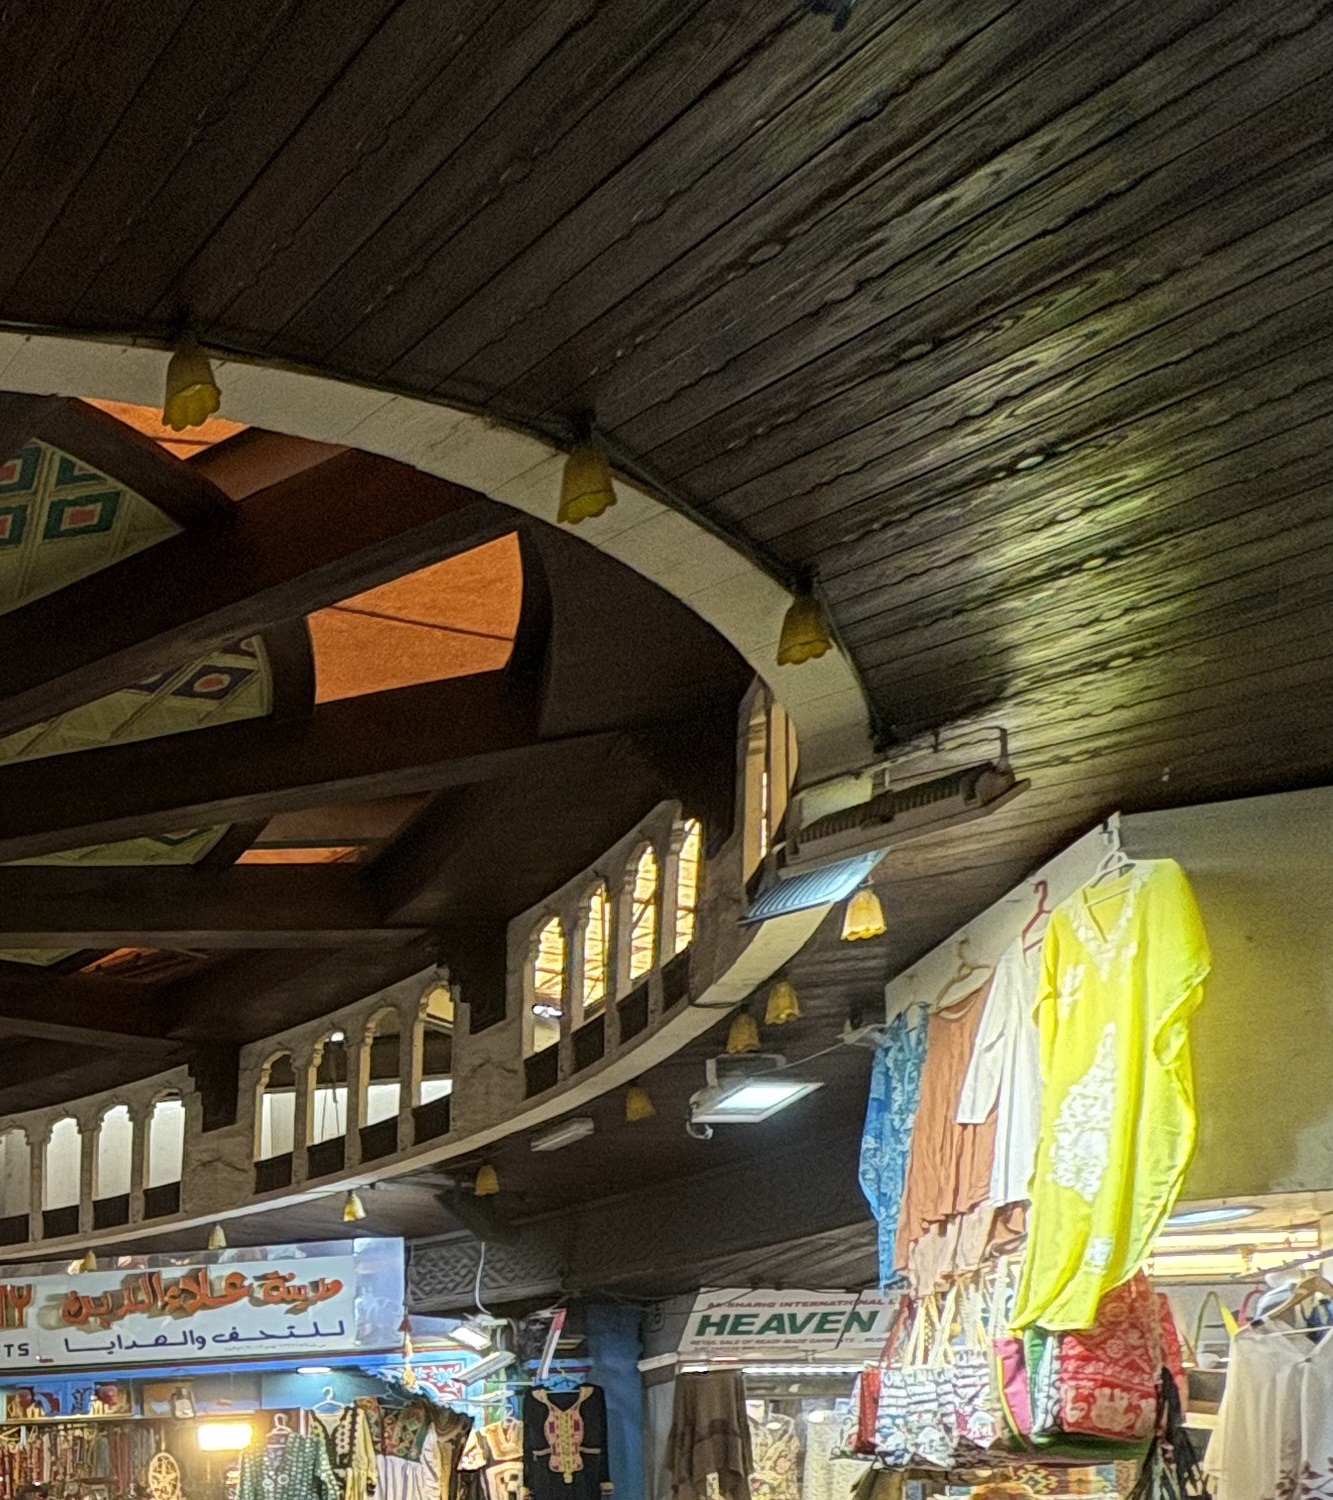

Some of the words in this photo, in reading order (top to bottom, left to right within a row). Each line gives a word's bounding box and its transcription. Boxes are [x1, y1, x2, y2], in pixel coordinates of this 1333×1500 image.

[211, 1320, 346, 1344] للتحف
[694, 1310, 880, 1336] HEAVEN
[63, 1329, 207, 1355] والهدايا
